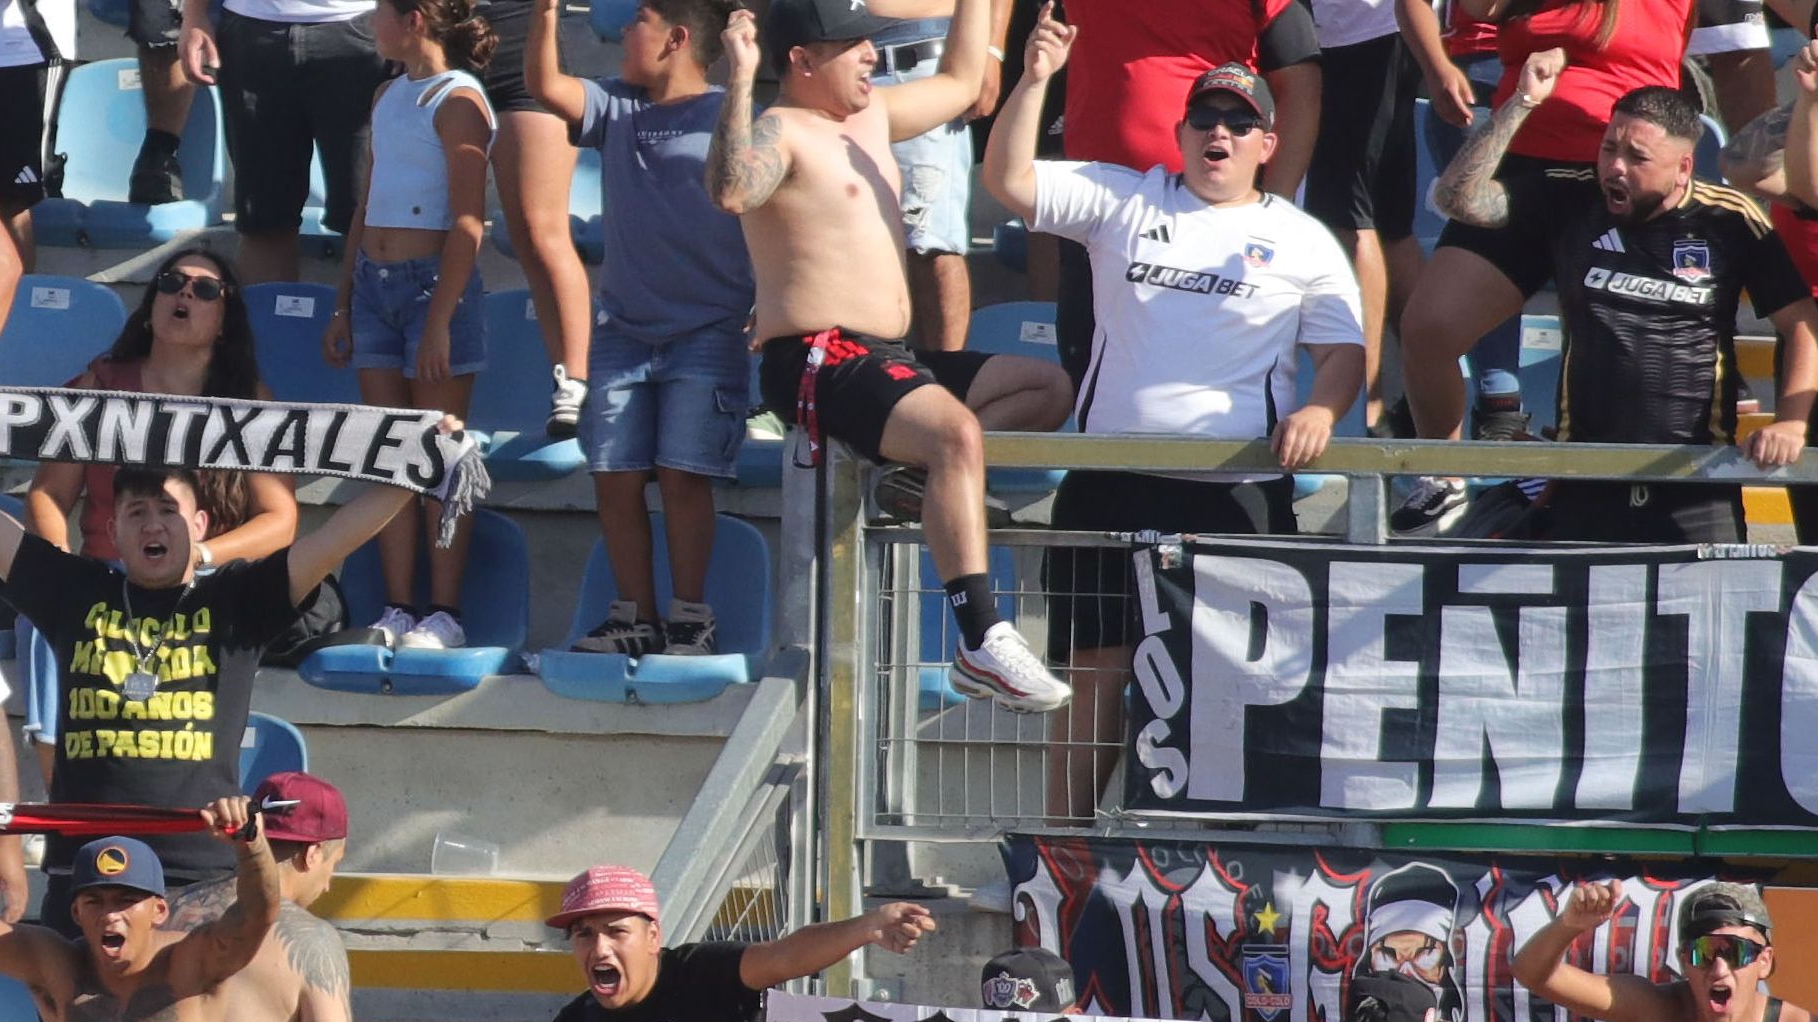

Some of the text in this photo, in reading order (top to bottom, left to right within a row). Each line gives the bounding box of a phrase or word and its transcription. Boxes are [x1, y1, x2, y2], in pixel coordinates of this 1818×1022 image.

[68, 687, 120, 720] 100
[64, 721, 213, 761] DE PASIÓN
